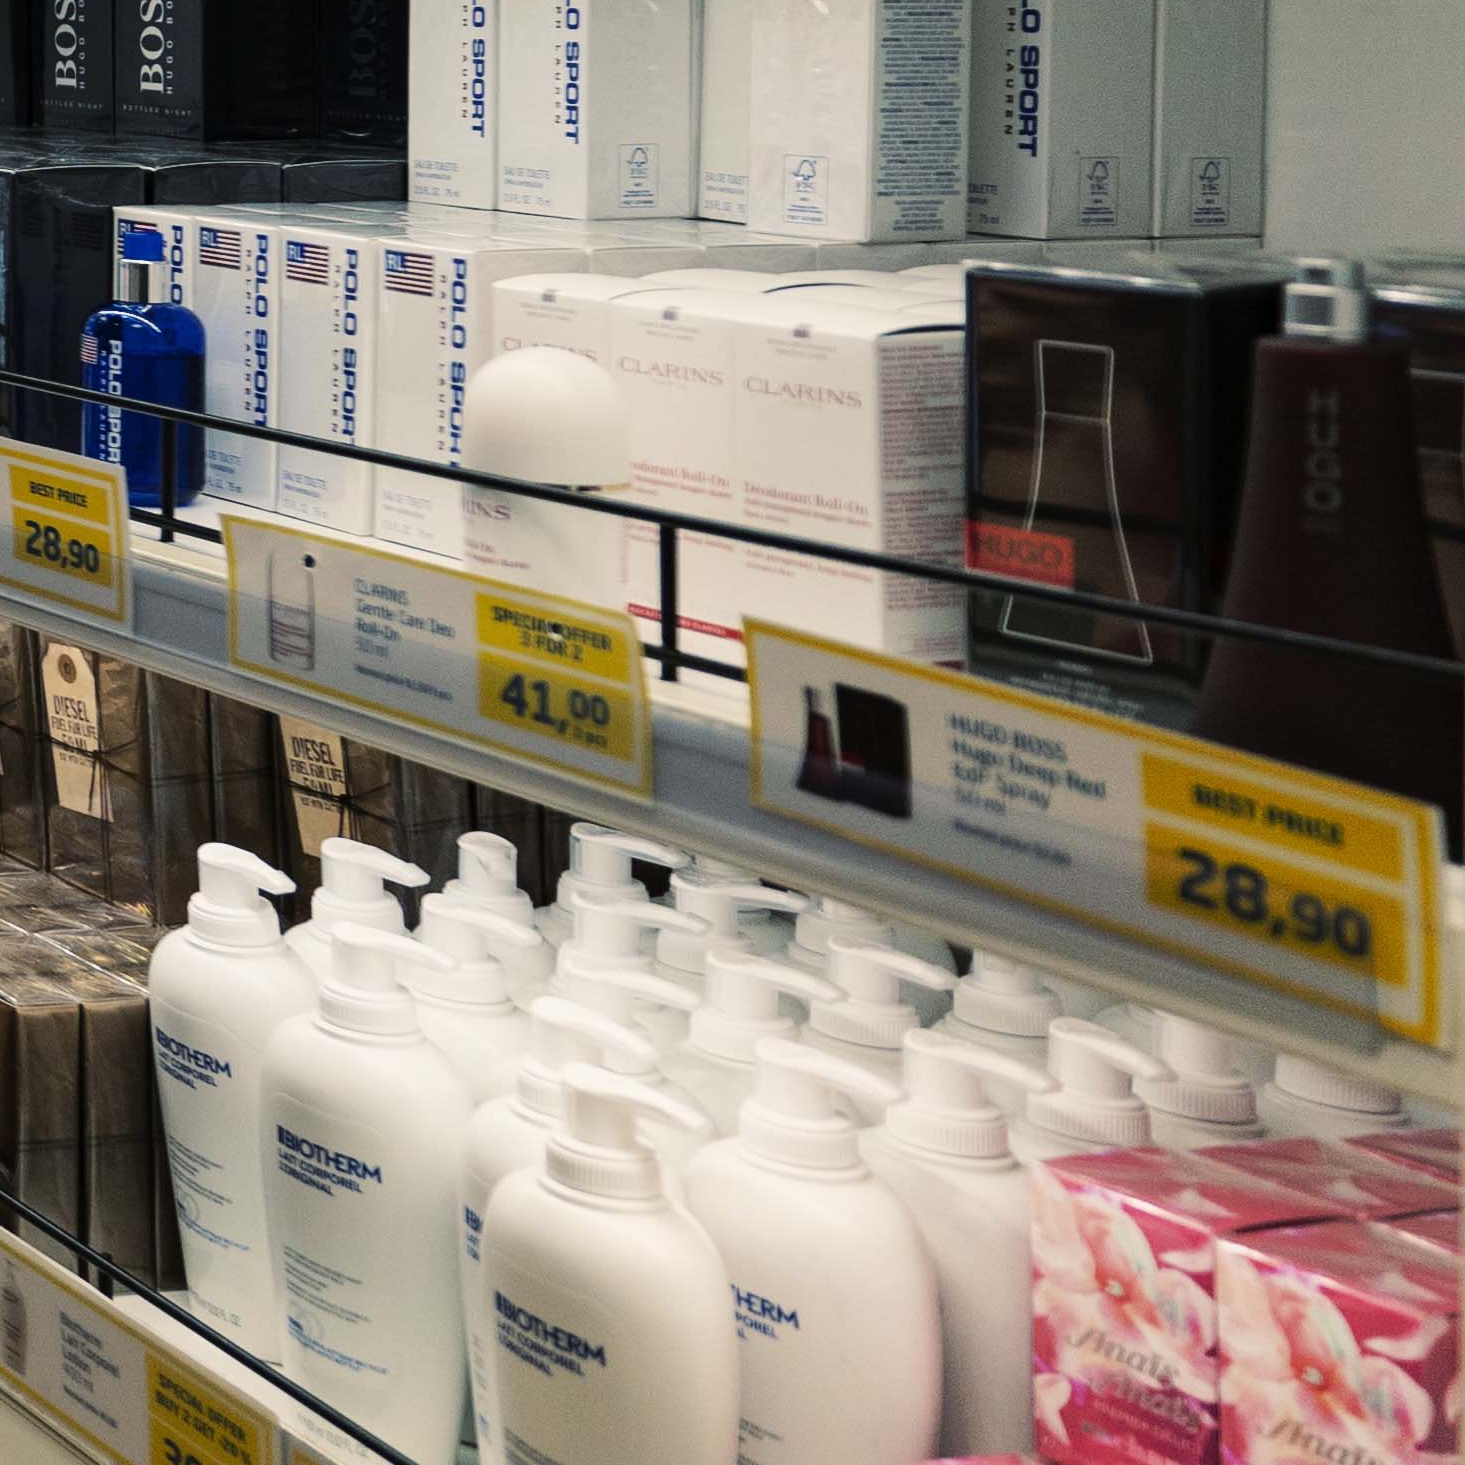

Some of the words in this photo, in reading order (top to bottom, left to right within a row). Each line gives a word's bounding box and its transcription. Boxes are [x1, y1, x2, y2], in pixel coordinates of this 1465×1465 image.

[471, 38, 486, 138] SPORT
[565, 40, 580, 145] SPORT
[1017, 45, 1041, 158] SPORT
[170, 225, 184, 305] POLO
[255, 234, 269, 318] POLO
[286, 244, 304, 263] RL
[343, 248, 358, 336] POLO
[450, 258, 467, 350] POLO
[619, 356, 724, 388] CLARINS
[742, 376, 863, 409] CLARINS
[29, 480, 55, 496] BEST
[57, 488, 88, 509] PRICE
[25, 519, 100, 574] 28,90
[51, 715, 67, 732] FUEL
[81, 722, 98, 739] LIFE
[53, 694, 91, 723] DIESEL
[502, 672, 610, 735] 41,00
[291, 736, 335, 767] DIESEL
[949, 713, 1006, 746] HUGO
[1013, 729, 1068, 763] BOSS
[290, 758, 309, 776] FUEL
[326, 767, 344, 784] LIFE
[1193, 782, 1259, 821] BEST
[1263, 805, 1345, 848] PRICE
[1178, 846, 1372, 959] 28,90
[156, 1025, 232, 1079] BIOTHERM
[277, 1124, 383, 1184] BIOTHERM
[278, 1148, 296, 1165] LAIT
[298, 1158, 365, 1194] CORPOREL
[495, 1291, 607, 1368] BIOTHERM
